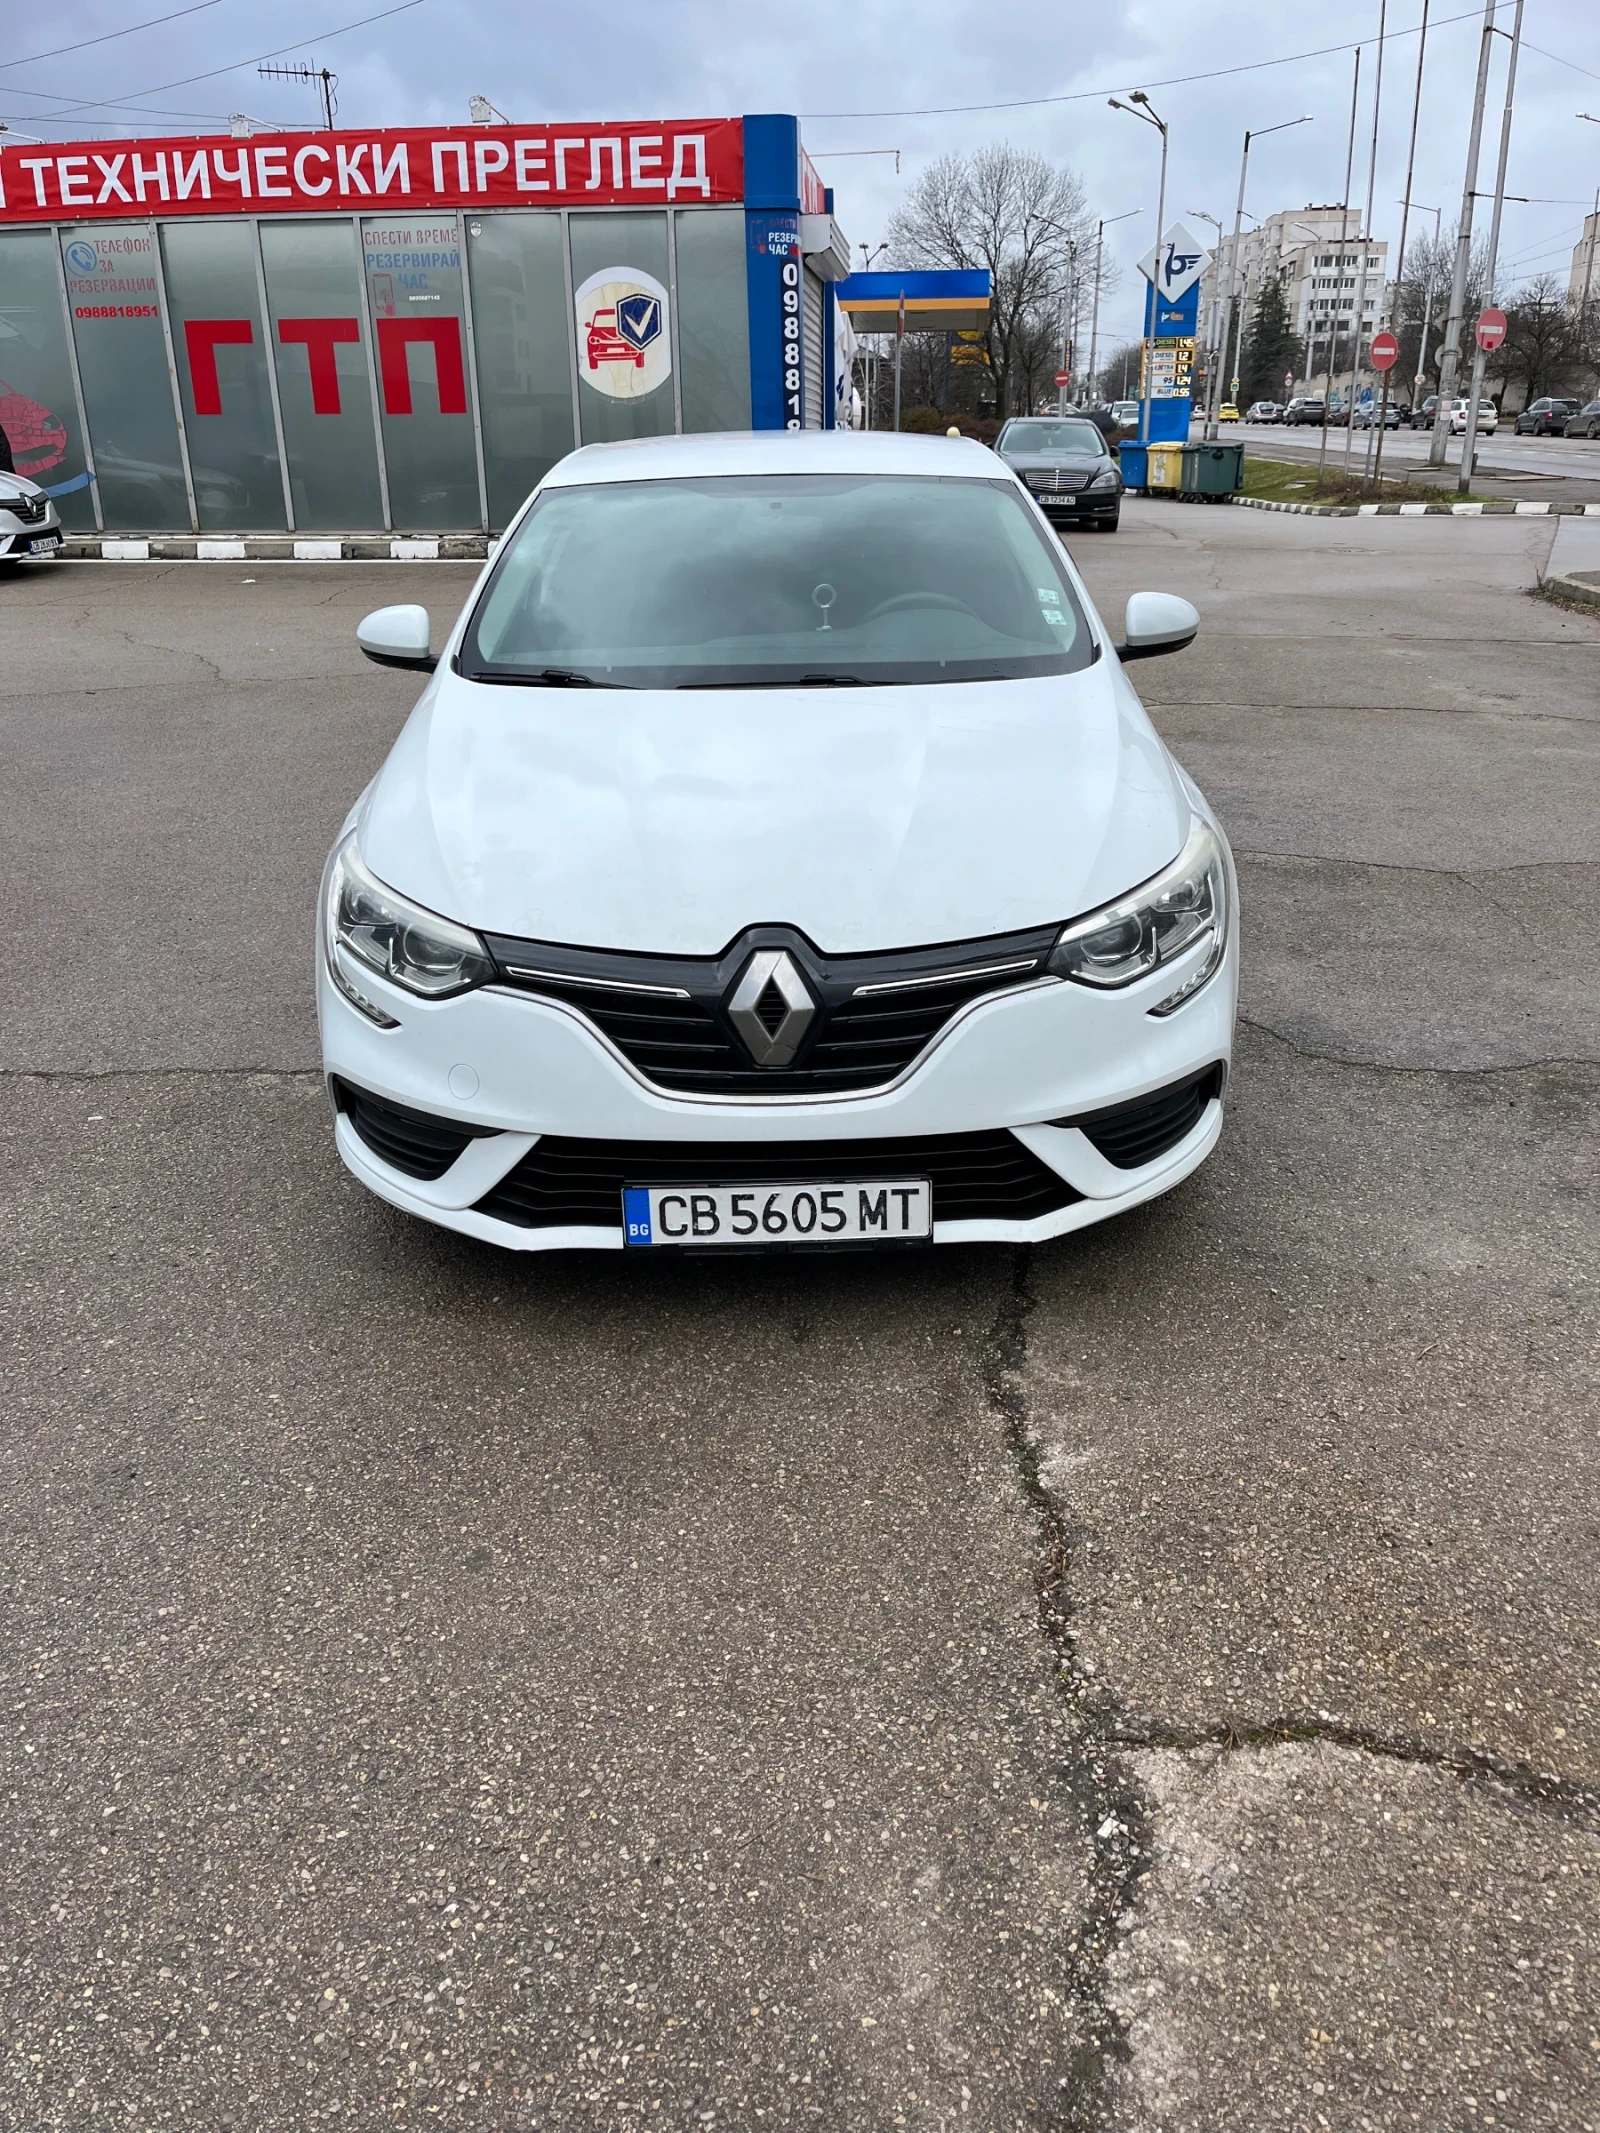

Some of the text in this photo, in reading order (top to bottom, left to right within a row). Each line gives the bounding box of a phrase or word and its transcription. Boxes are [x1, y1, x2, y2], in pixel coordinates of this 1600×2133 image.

[19, 144, 411, 206] ТЕХНИЧЕСКИ
[431, 134, 711, 199] ПРЕГЛЕД
[93, 236, 151, 255] ТЕЛЕФОН
[364, 230, 412, 246] СПЕСТИ
[768, 243, 788, 256] ЧАС
[99, 259, 115, 274] ЗА
[366, 249, 460, 268] РЕЗЕРВИРАЙ
[69, 277, 156, 294] РЕЗЕРВАЦИИ
[397, 273, 429, 290] ЧАС
[75, 305, 159, 319] 0988818951
[184, 316, 467, 416] ГТП
[1163, 377, 1173, 385] 95
[658, 1188, 920, 1237] CB 5605 MT
[629, 1223, 649, 1237] BG
